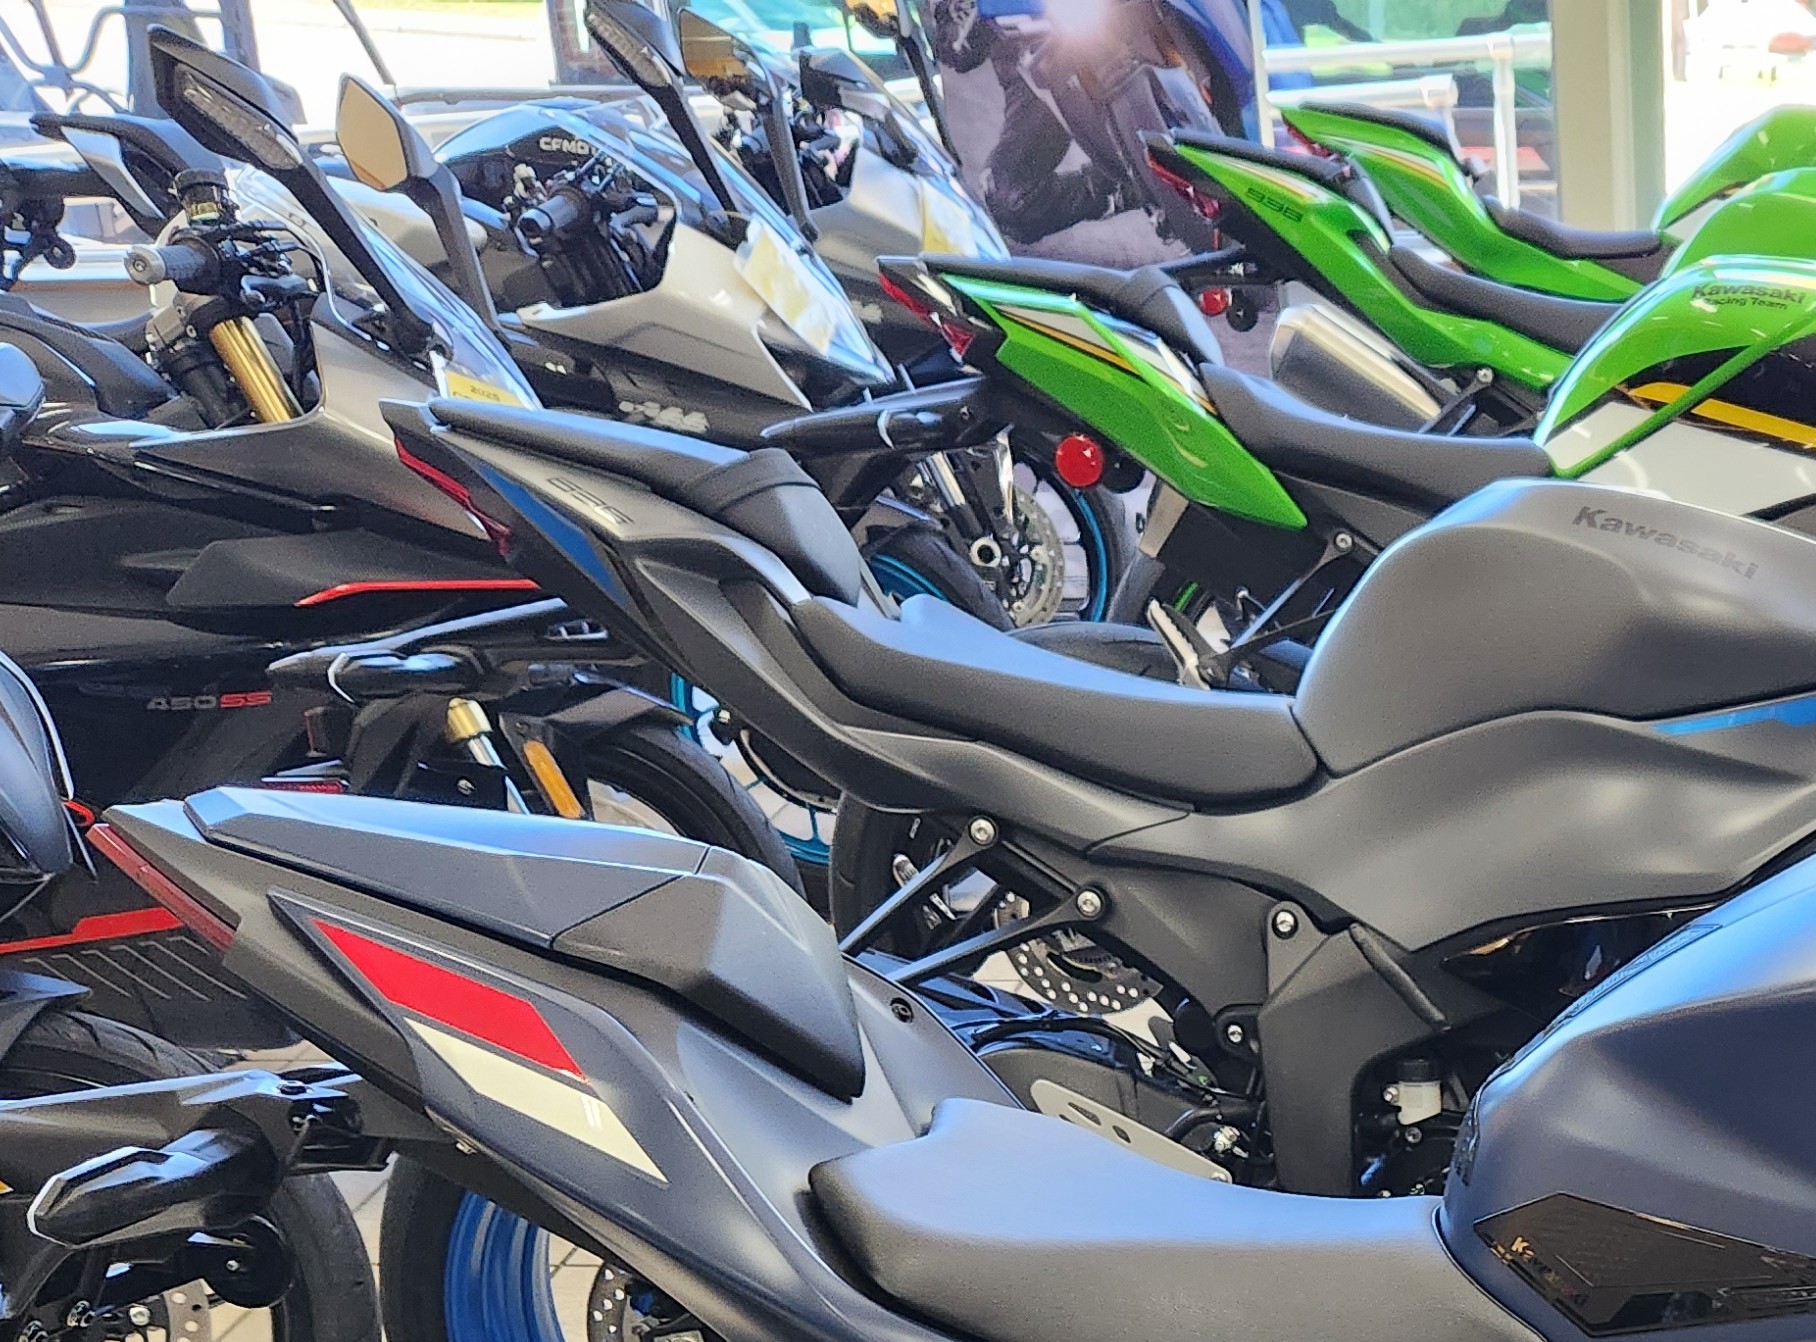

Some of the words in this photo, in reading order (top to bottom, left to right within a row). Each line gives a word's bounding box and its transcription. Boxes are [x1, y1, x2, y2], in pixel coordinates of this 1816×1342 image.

[1691, 284, 1806, 304] Kawasaki
[1749, 296, 1789, 310] Team
[1572, 505, 1760, 580] Kawasaki
